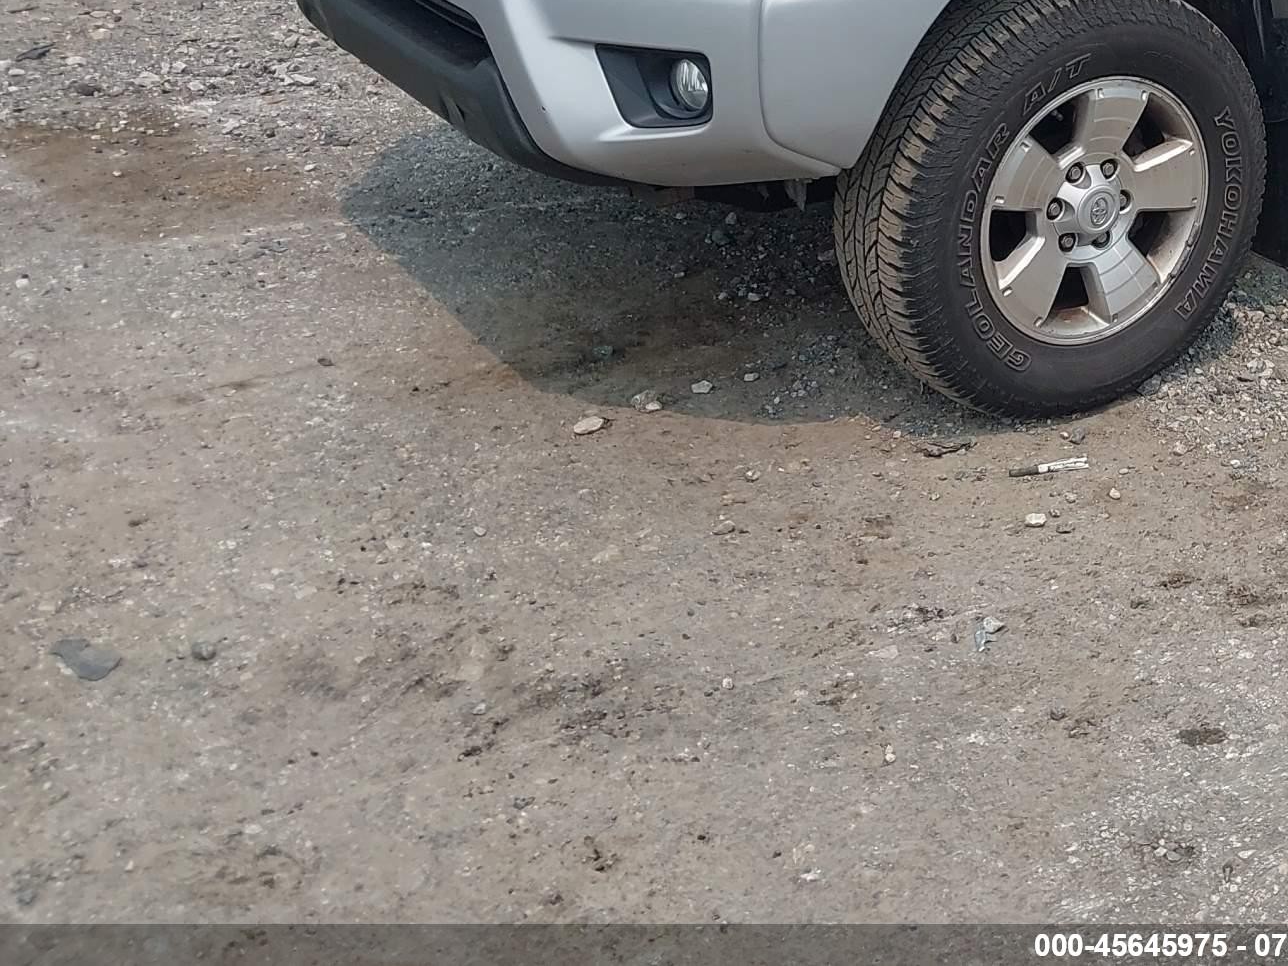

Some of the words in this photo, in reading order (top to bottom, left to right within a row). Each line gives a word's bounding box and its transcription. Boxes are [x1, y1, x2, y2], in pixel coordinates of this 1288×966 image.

[957, 122, 1032, 372] GEOLANDAR
[1023, 53, 1092, 112] A/T
[1173, 105, 1245, 323] YOKOHAMA
